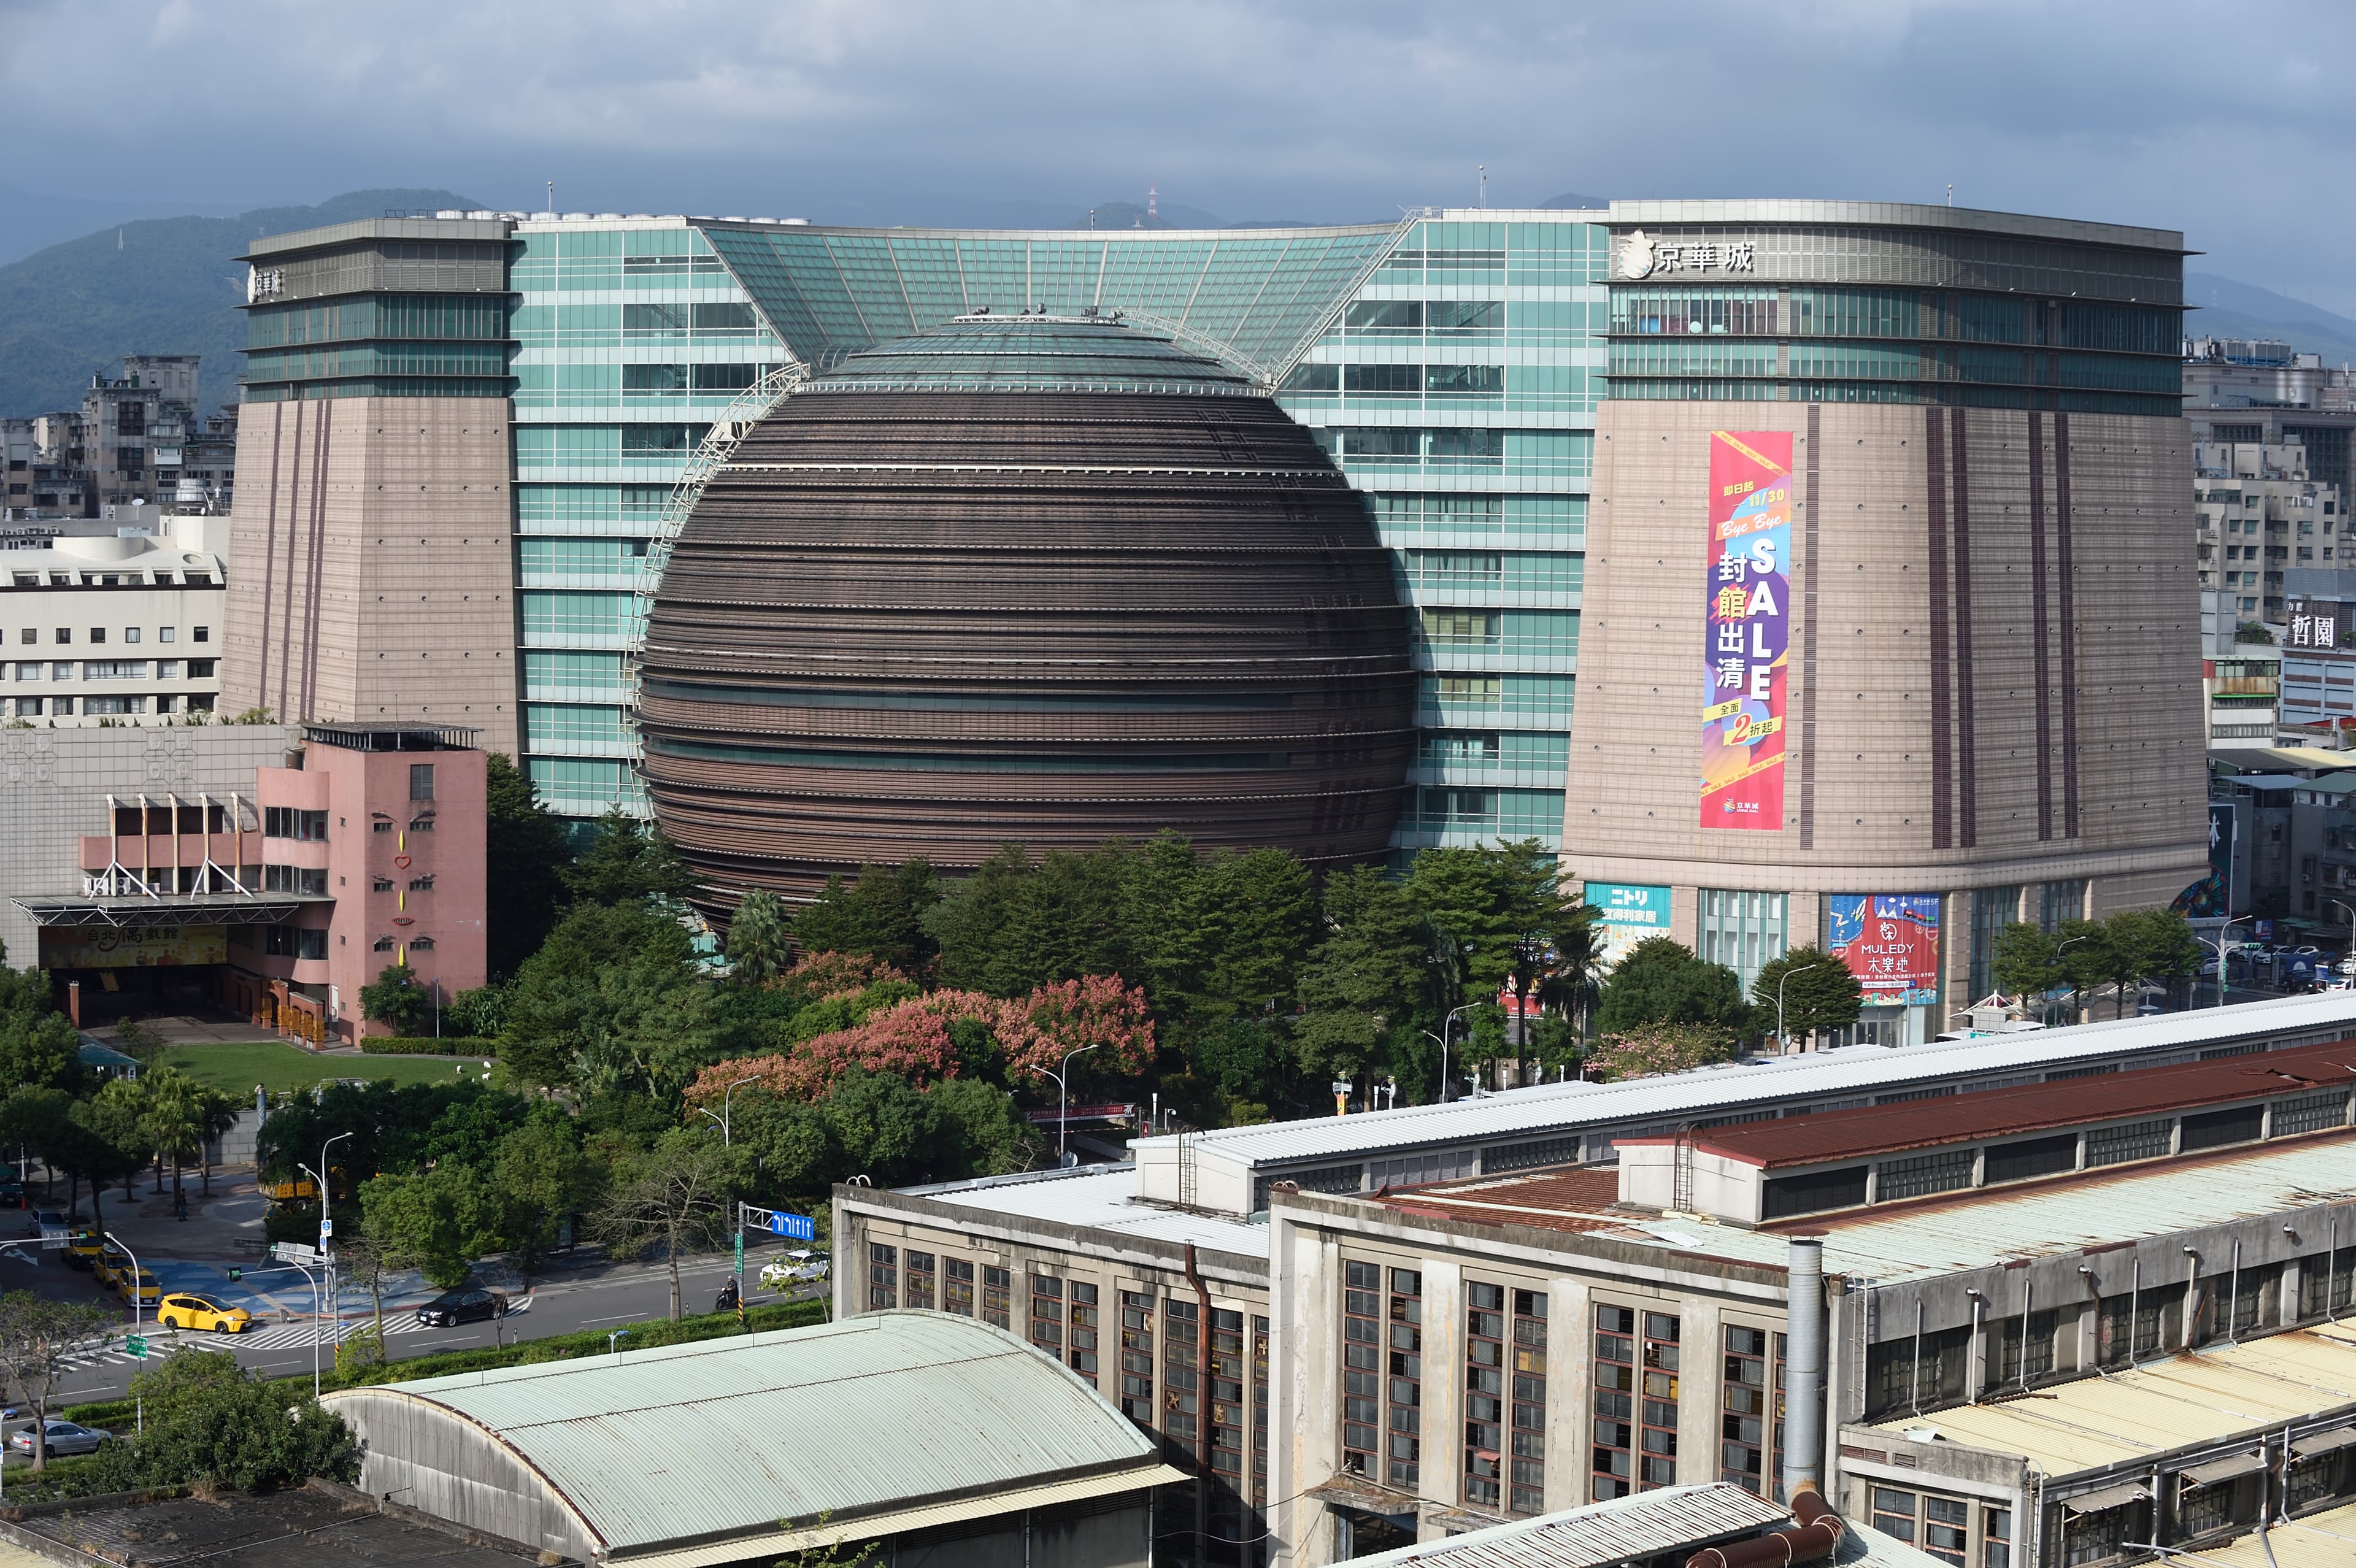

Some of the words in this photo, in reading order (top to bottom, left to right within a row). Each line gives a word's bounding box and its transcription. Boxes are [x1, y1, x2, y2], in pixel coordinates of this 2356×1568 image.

[1655, 241, 1753, 271] 京華城
[255, 269, 280, 296] 京華城
[1723, 481, 1754, 496] 即日起
[1749, 489, 1785, 507] 11/30
[1721, 520, 1748, 537] Bye
[1753, 513, 1782, 530] Bye
[1716, 551, 1748, 690] 封館出清
[1746, 538, 1779, 701] SALE
[2292, 615, 2335, 648] 哲園
[1720, 703, 1739, 715] 全面
[1731, 714, 1773, 744] 2折起
[1611, 889, 1648, 906] ニトリ
[1602, 908, 1657, 923] 宜得利家居
[88, 926, 179, 950] 台北偶戲館
[1861, 943, 1915, 955] MULEDY
[1868, 957, 1908, 973] 木樂地
